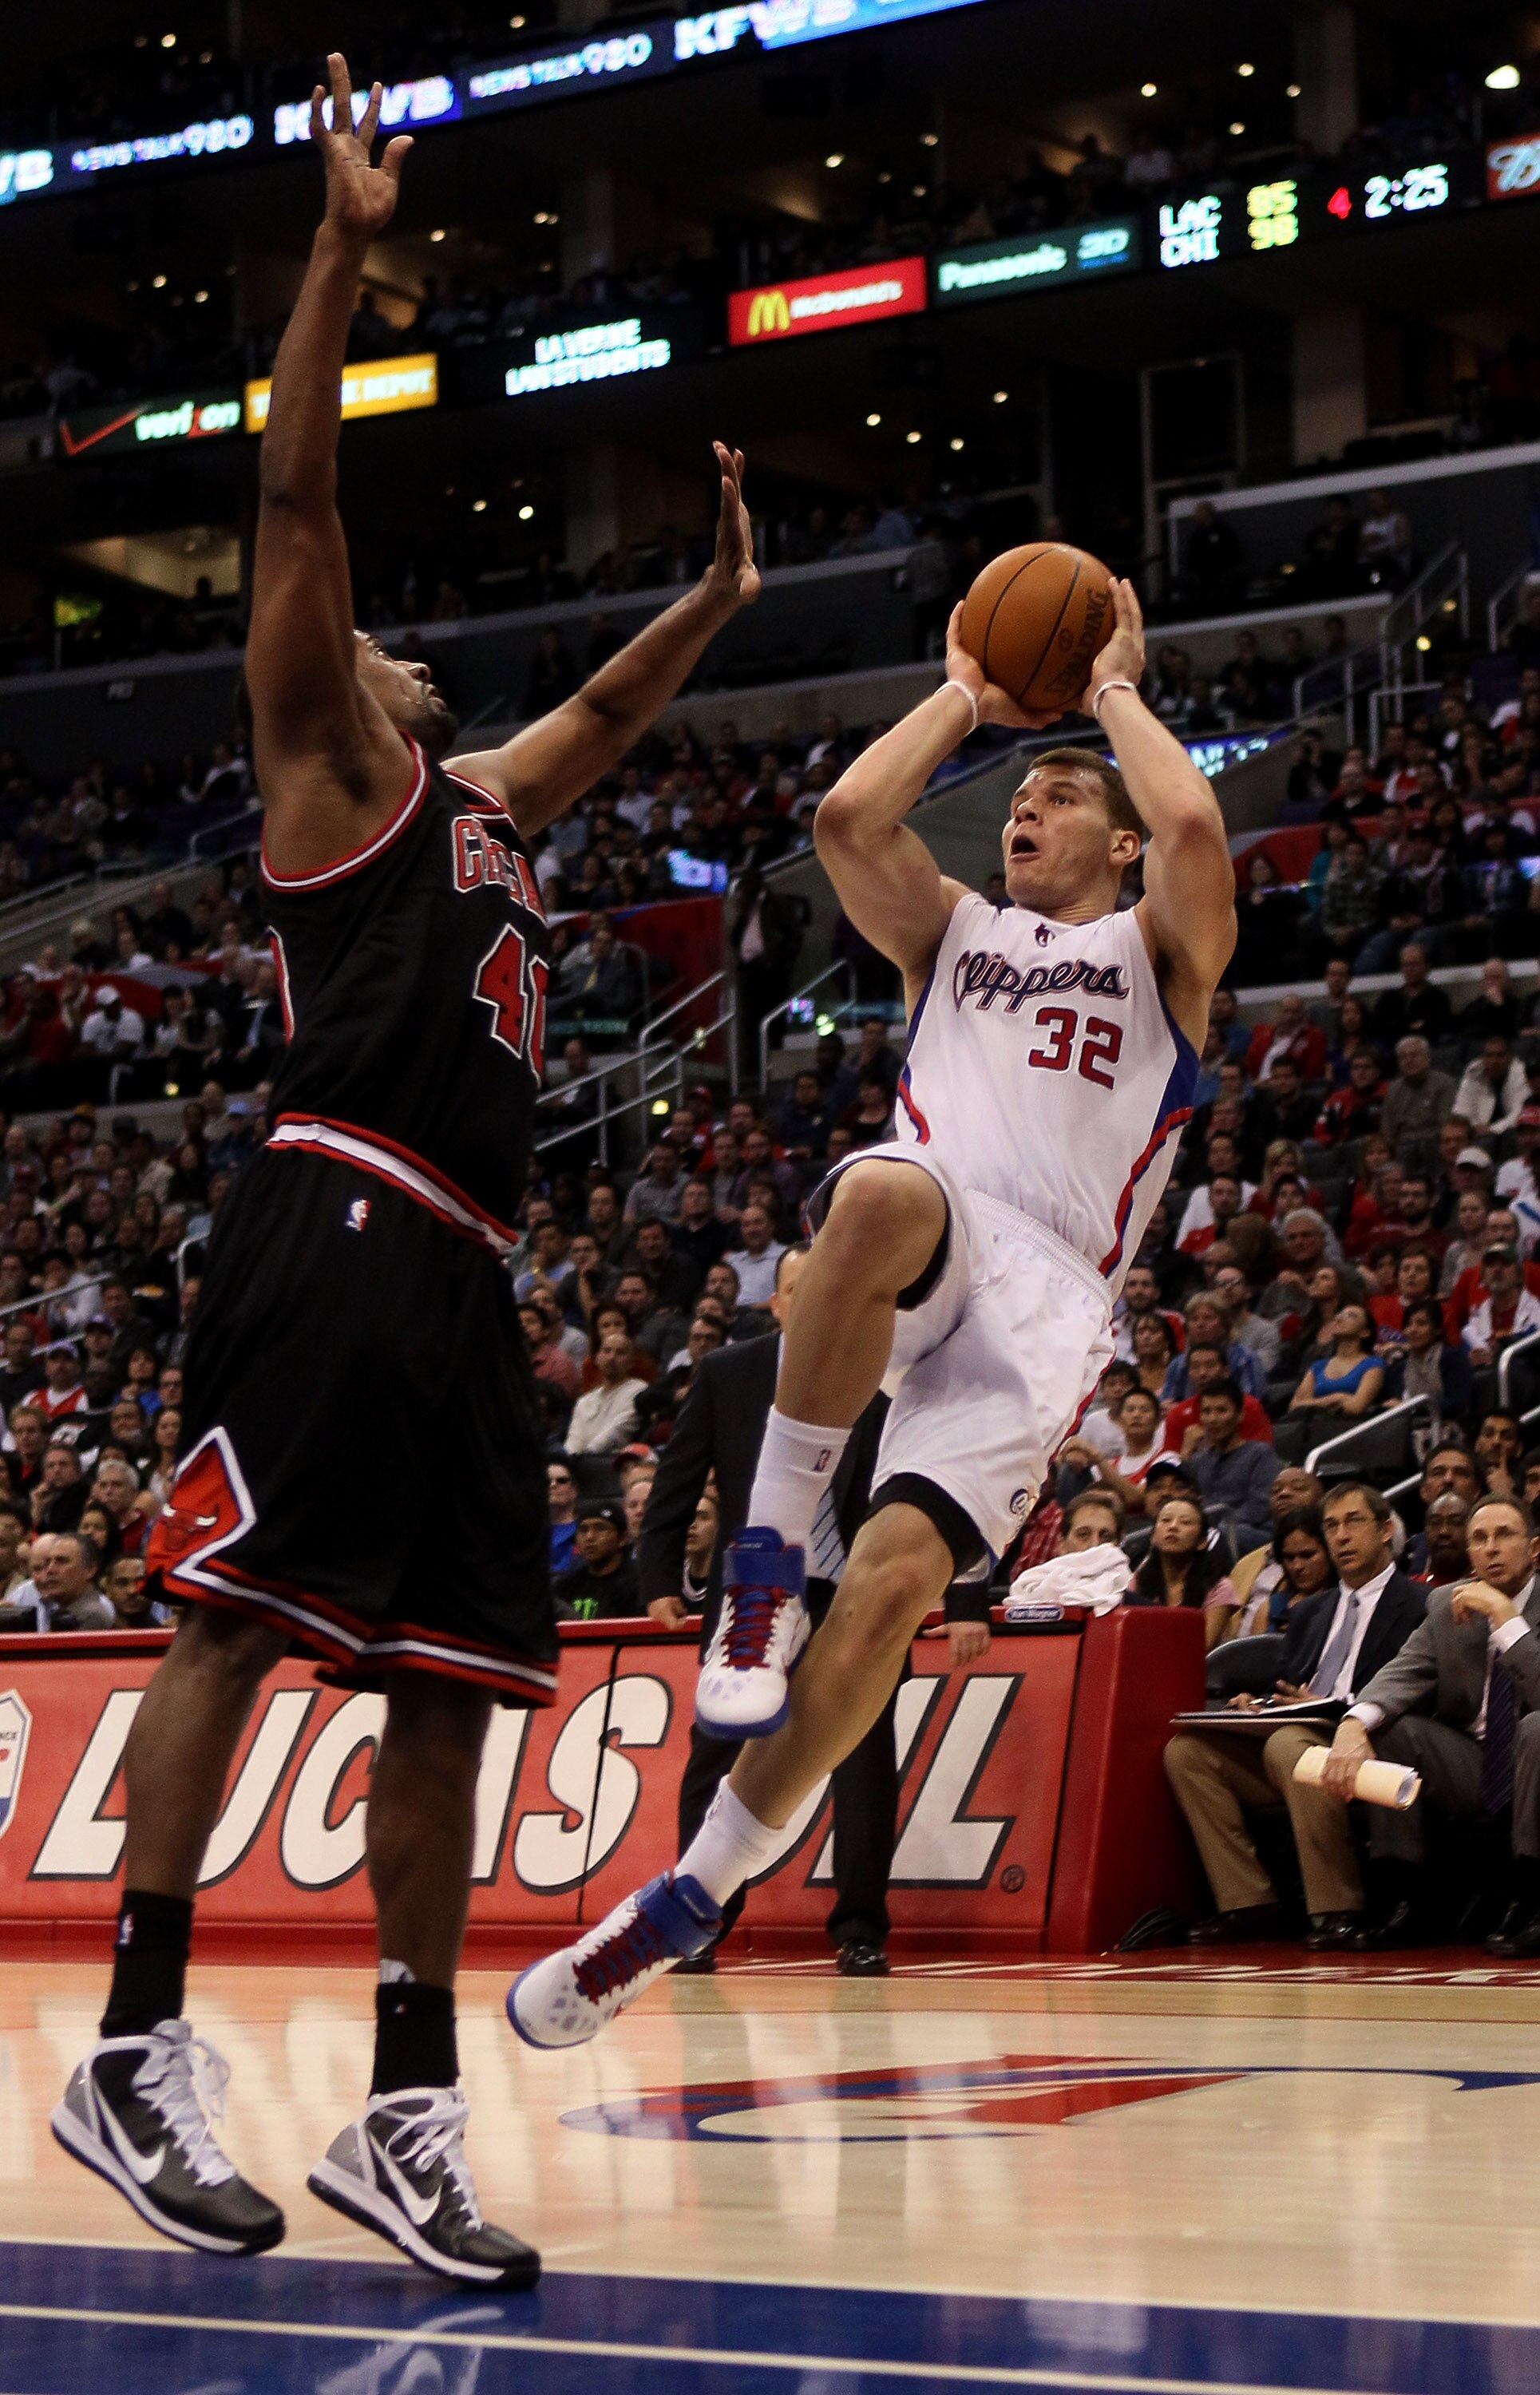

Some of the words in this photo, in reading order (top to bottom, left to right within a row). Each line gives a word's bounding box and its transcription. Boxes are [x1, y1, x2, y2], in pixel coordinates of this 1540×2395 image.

[1159, 196, 1221, 237] LAC
[1246, 180, 1298, 219] 85
[1328, 186, 1352, 219] 4
[1364, 164, 1448, 218] 2:25
[939, 243, 1068, 291] Panasonic
[1160, 228, 1220, 267] CHI
[136, 400, 240, 441] verizon
[952, 949, 1131, 1012] Clippers
[1028, 1007, 1123, 1091] 32
